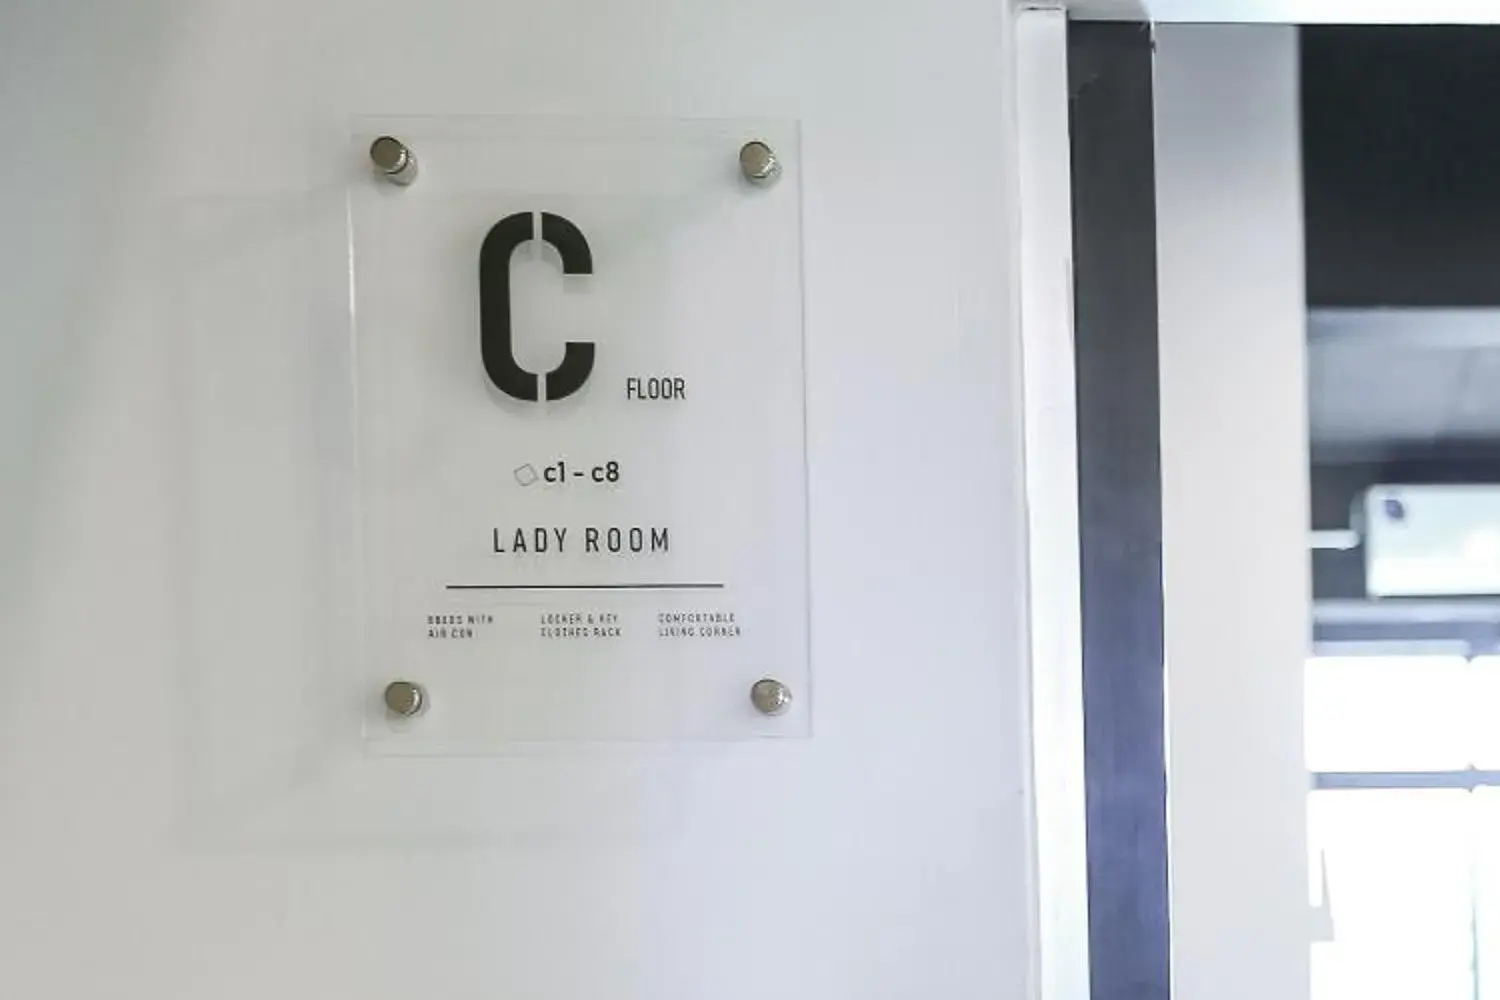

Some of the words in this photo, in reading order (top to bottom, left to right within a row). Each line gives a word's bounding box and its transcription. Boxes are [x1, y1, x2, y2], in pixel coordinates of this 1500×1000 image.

[478, 211, 596, 402] C
[626, 377, 686, 401] FLOOR
[543, 460, 567, 484] c1
[591, 460, 621, 484] c8
[493, 527, 568, 554] LADY
[585, 527, 670, 554] ROOM
